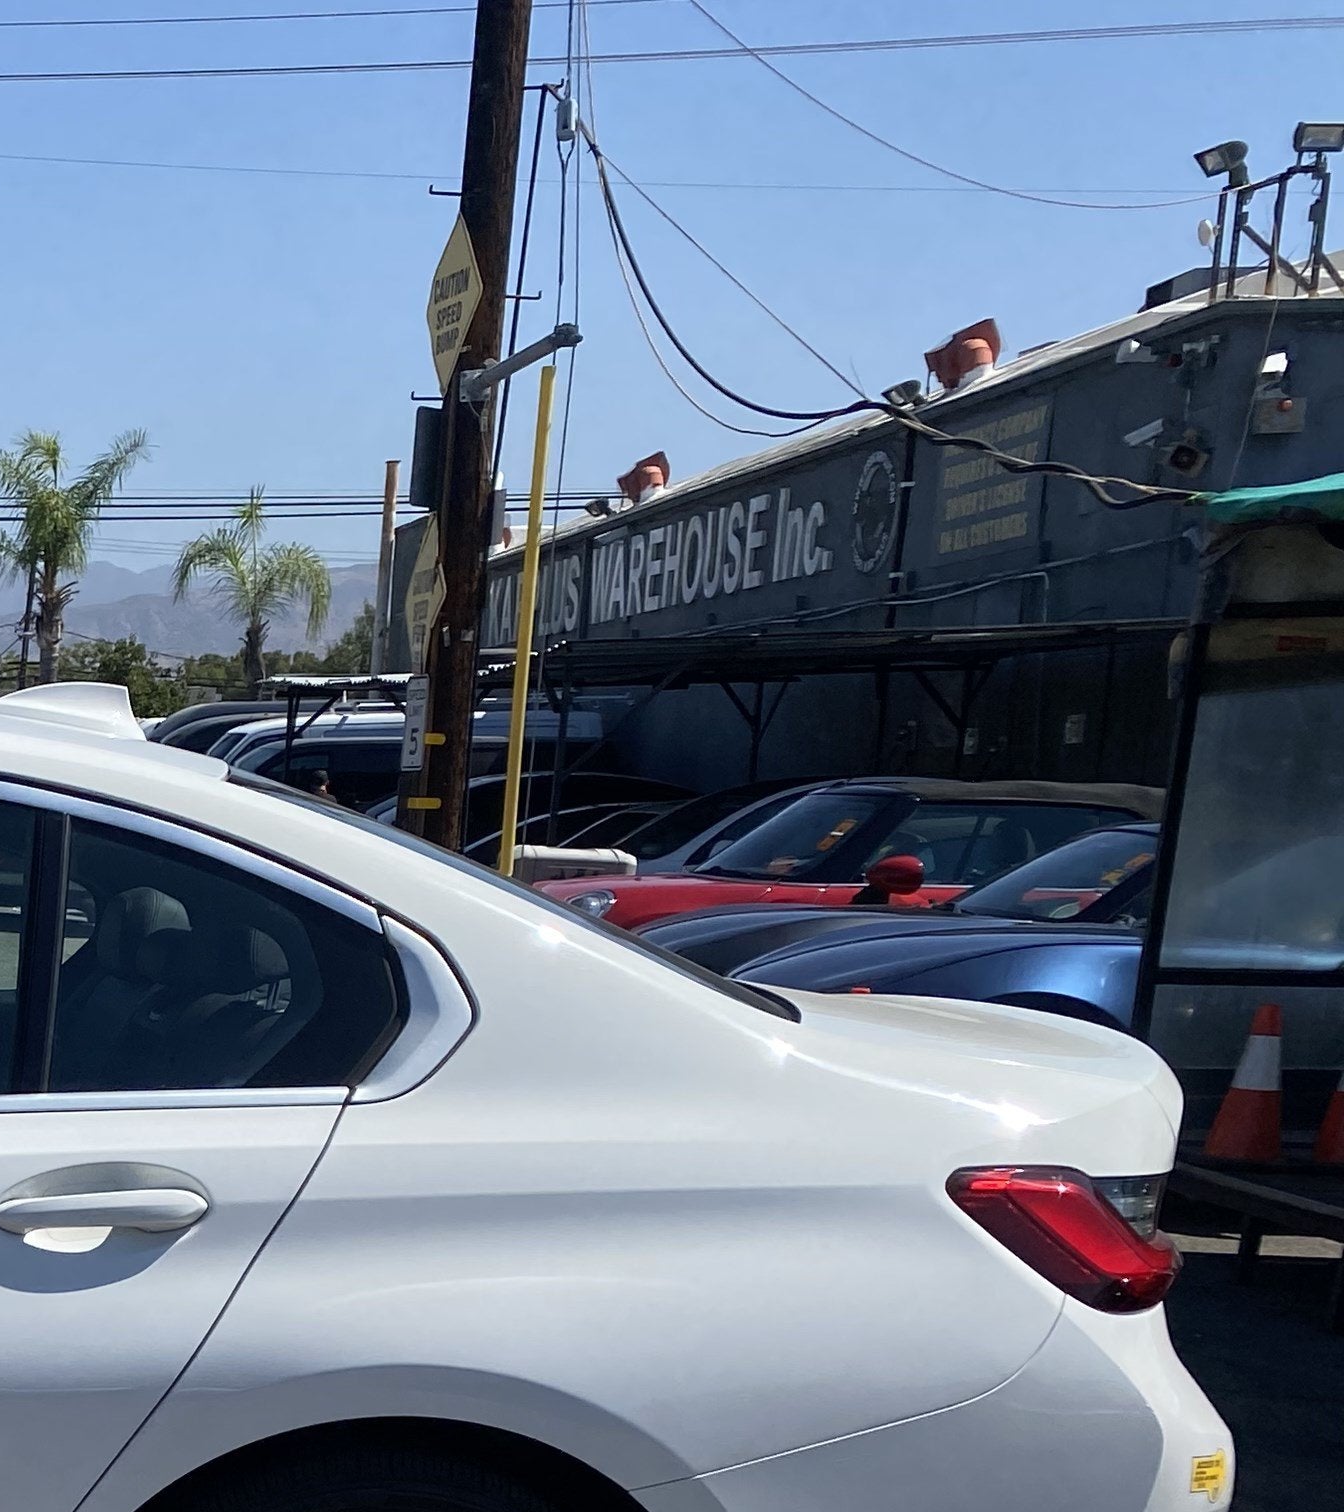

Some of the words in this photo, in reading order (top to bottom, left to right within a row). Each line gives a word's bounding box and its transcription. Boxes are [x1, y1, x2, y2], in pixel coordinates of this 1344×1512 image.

[434, 266, 471, 305] CAUTION
[436, 301, 463, 330] SPEED
[436, 327, 460, 356] BUMP
[591, 493, 772, 625] WAREHOUSE
[772, 487, 834, 582] Inc.
[408, 727, 420, 756] 5
